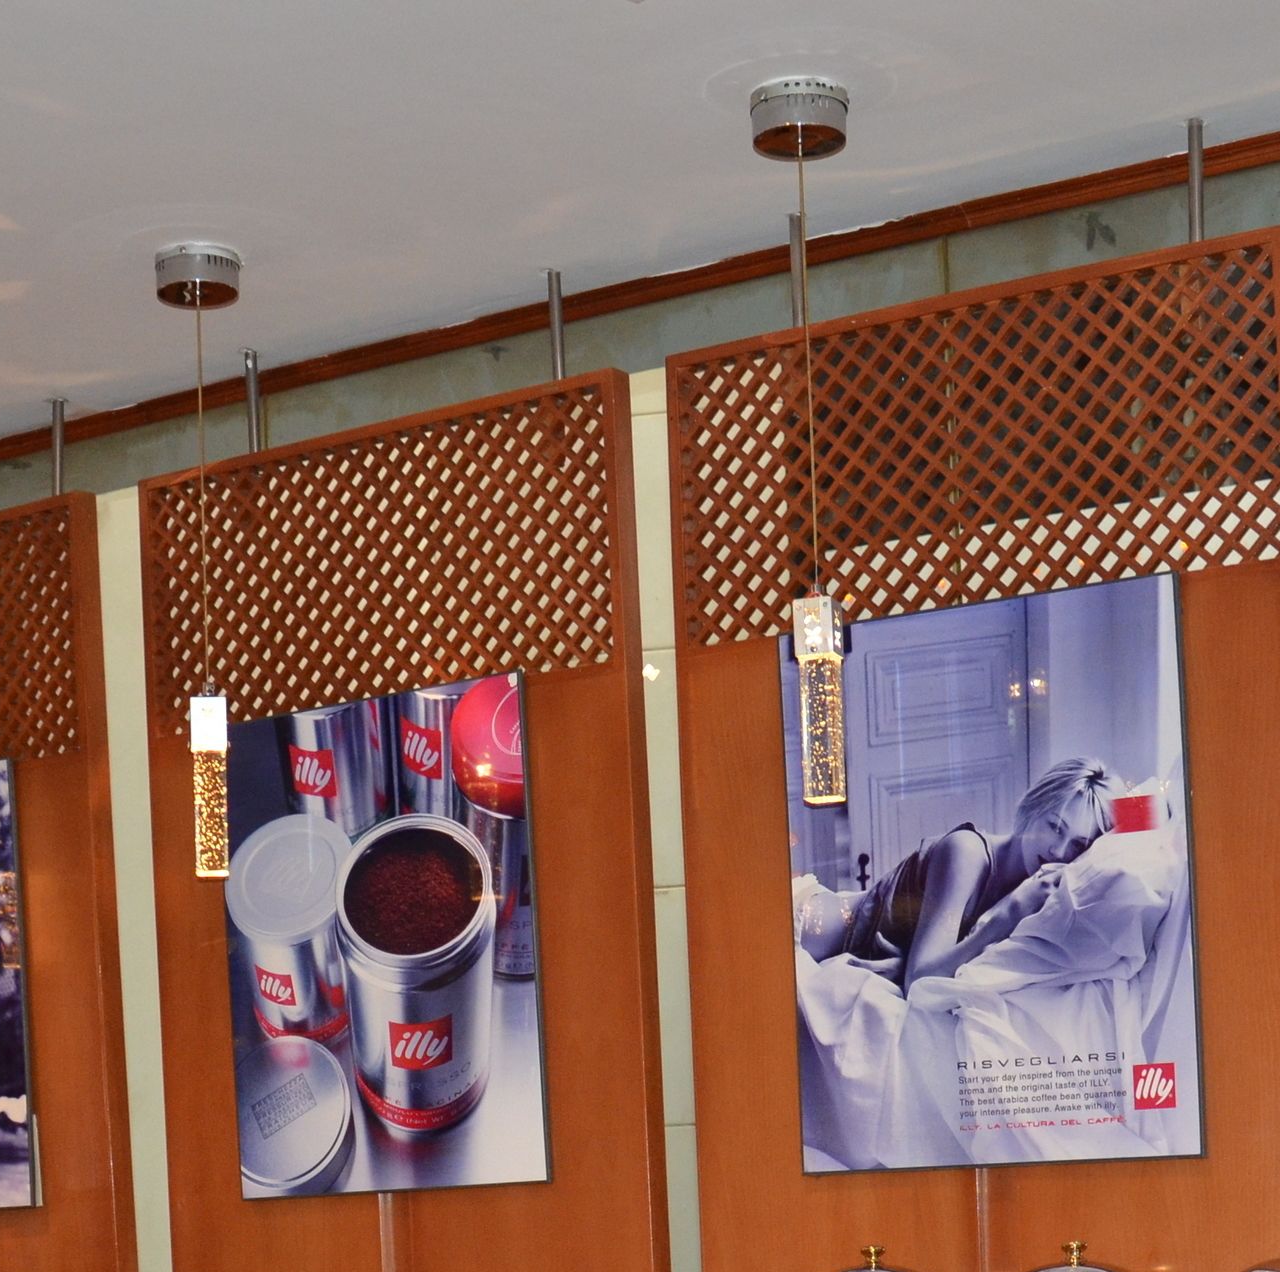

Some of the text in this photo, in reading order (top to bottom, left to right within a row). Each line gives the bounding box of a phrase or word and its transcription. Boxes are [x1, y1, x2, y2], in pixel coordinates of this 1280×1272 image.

[403, 731, 439, 771] illy
[294, 756, 332, 793] illy
[260, 974, 292, 1003] illy
[394, 1030, 449, 1066] illy
[956, 1051, 1125, 1071] RISVEGLIARSI
[958, 1076, 979, 1085] Start
[981, 1076, 1000, 1084] your
[1001, 1074, 1017, 1083] day
[1019, 1071, 1053, 1081] inspired
[1055, 1070, 1075, 1078] from
[1093, 1067, 1122, 1077] unique
[958, 1087, 985, 1096] aroma
[1005, 1084, 1019, 1092] the
[1021, 1082, 1053, 1093] original
[1078, 1080, 1088, 1088] of
[1135, 1067, 1174, 1106] illy
[959, 1090, 1127, 1106] The best arabica coffee bean guarantee
[959, 1110, 978, 1119] your
[979, 1108, 1011, 1117] intense
[1013, 1106, 1052, 1116] pleasure.
[1054, 1104, 1082, 1112] Awake
[1084, 1102, 1103, 1110] with
[1006, 1120, 1056, 1129] CULTURA
[1061, 1119, 1082, 1127] DEL
